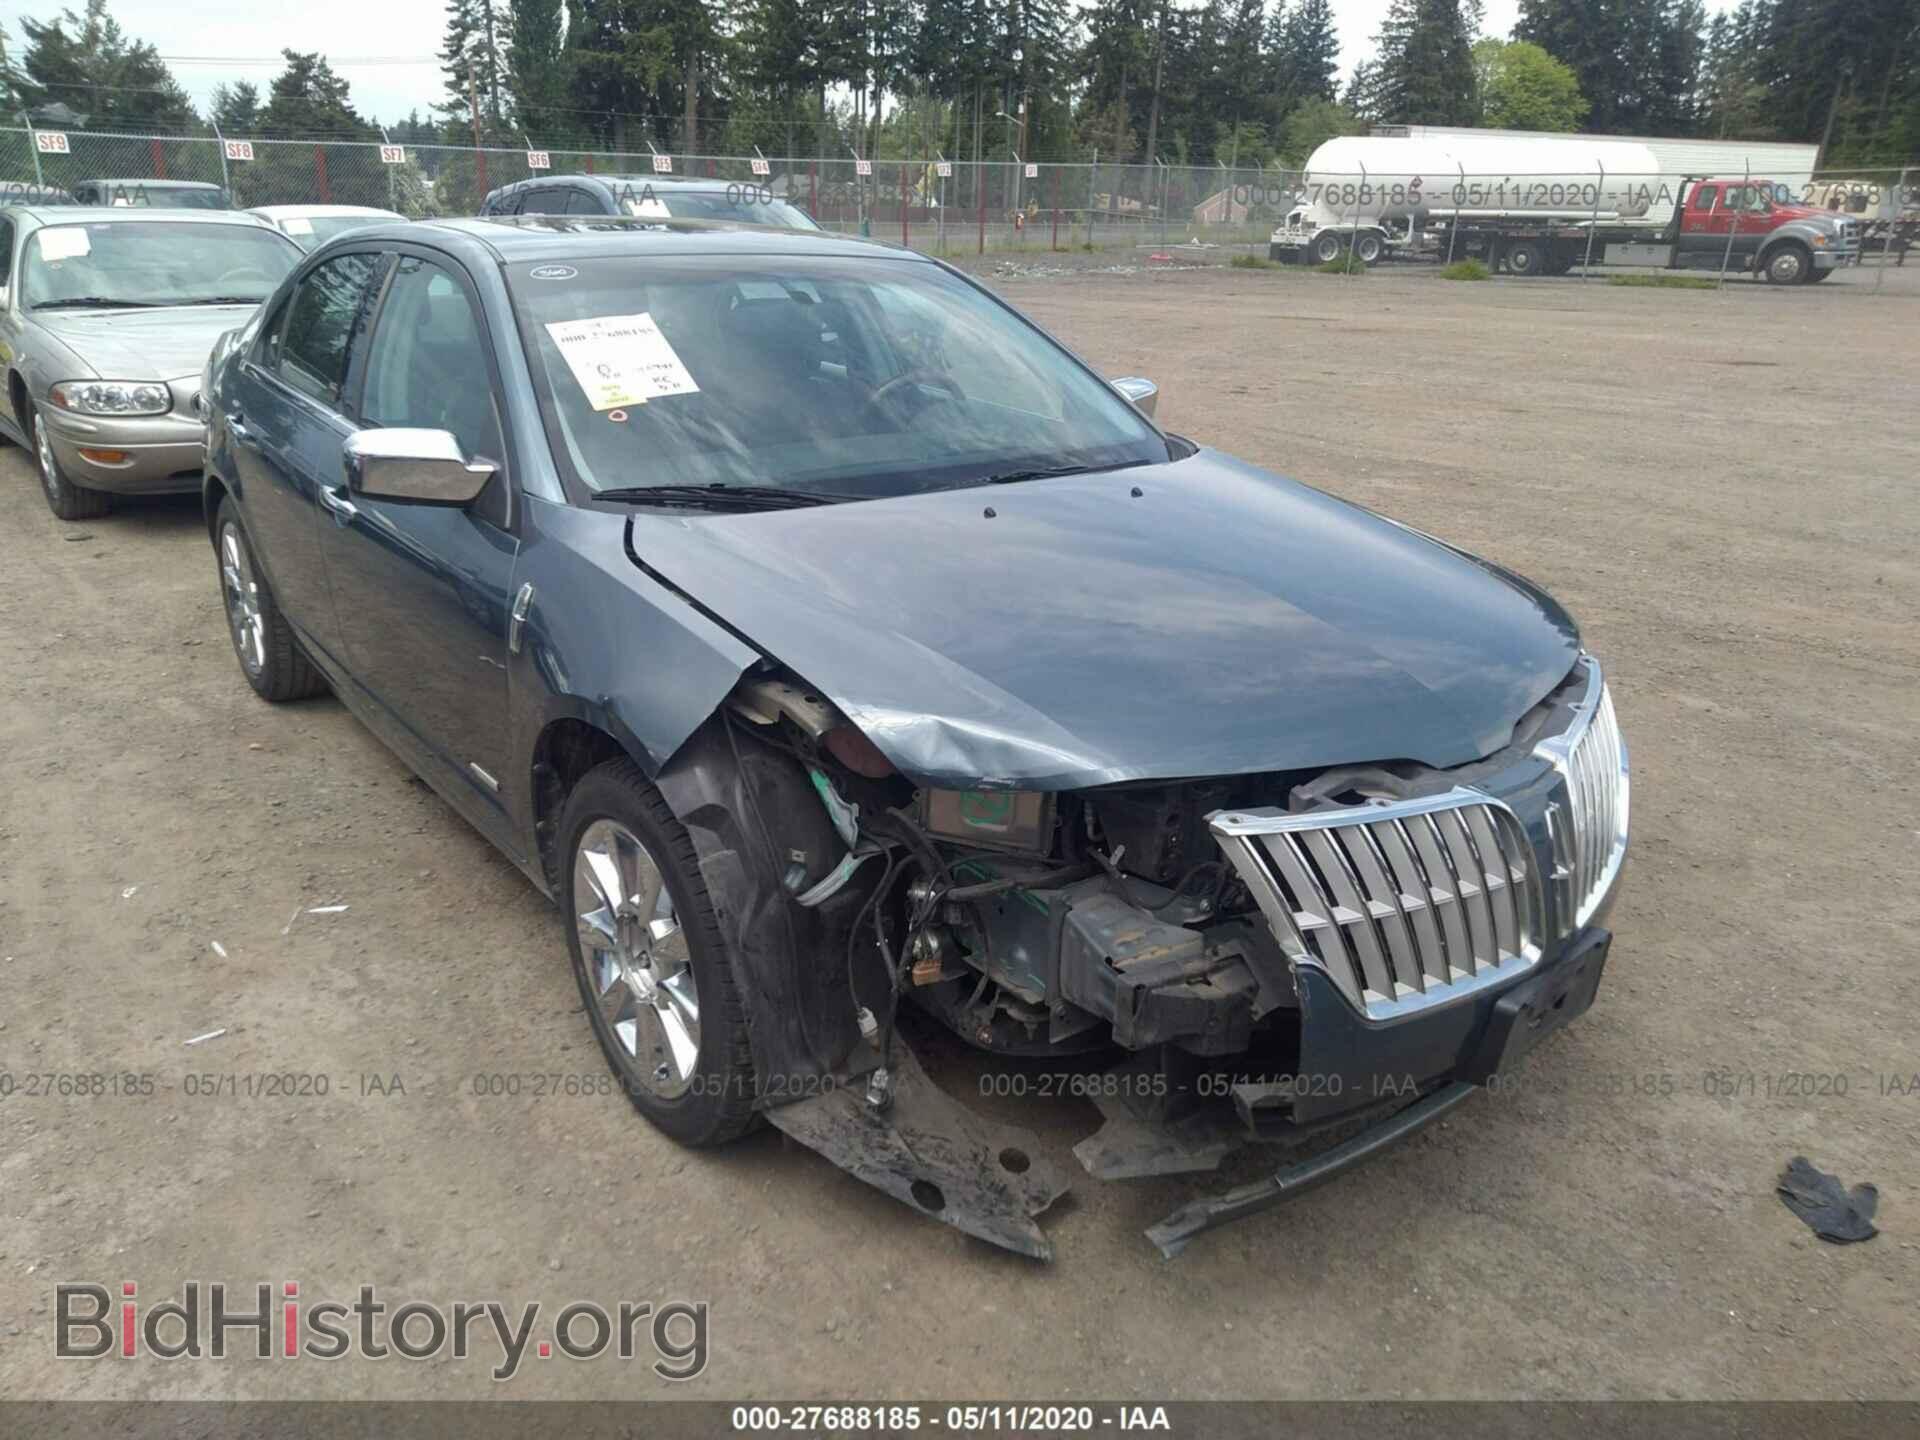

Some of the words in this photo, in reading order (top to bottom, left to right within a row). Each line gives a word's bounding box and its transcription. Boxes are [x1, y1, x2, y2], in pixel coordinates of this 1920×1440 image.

[37, 134, 68, 151] SF9
[226, 141, 253, 159] SF8
[382, 146, 402, 162] SF7
[528, 151, 549, 168] SF6
[654, 156, 672, 172] SF5
